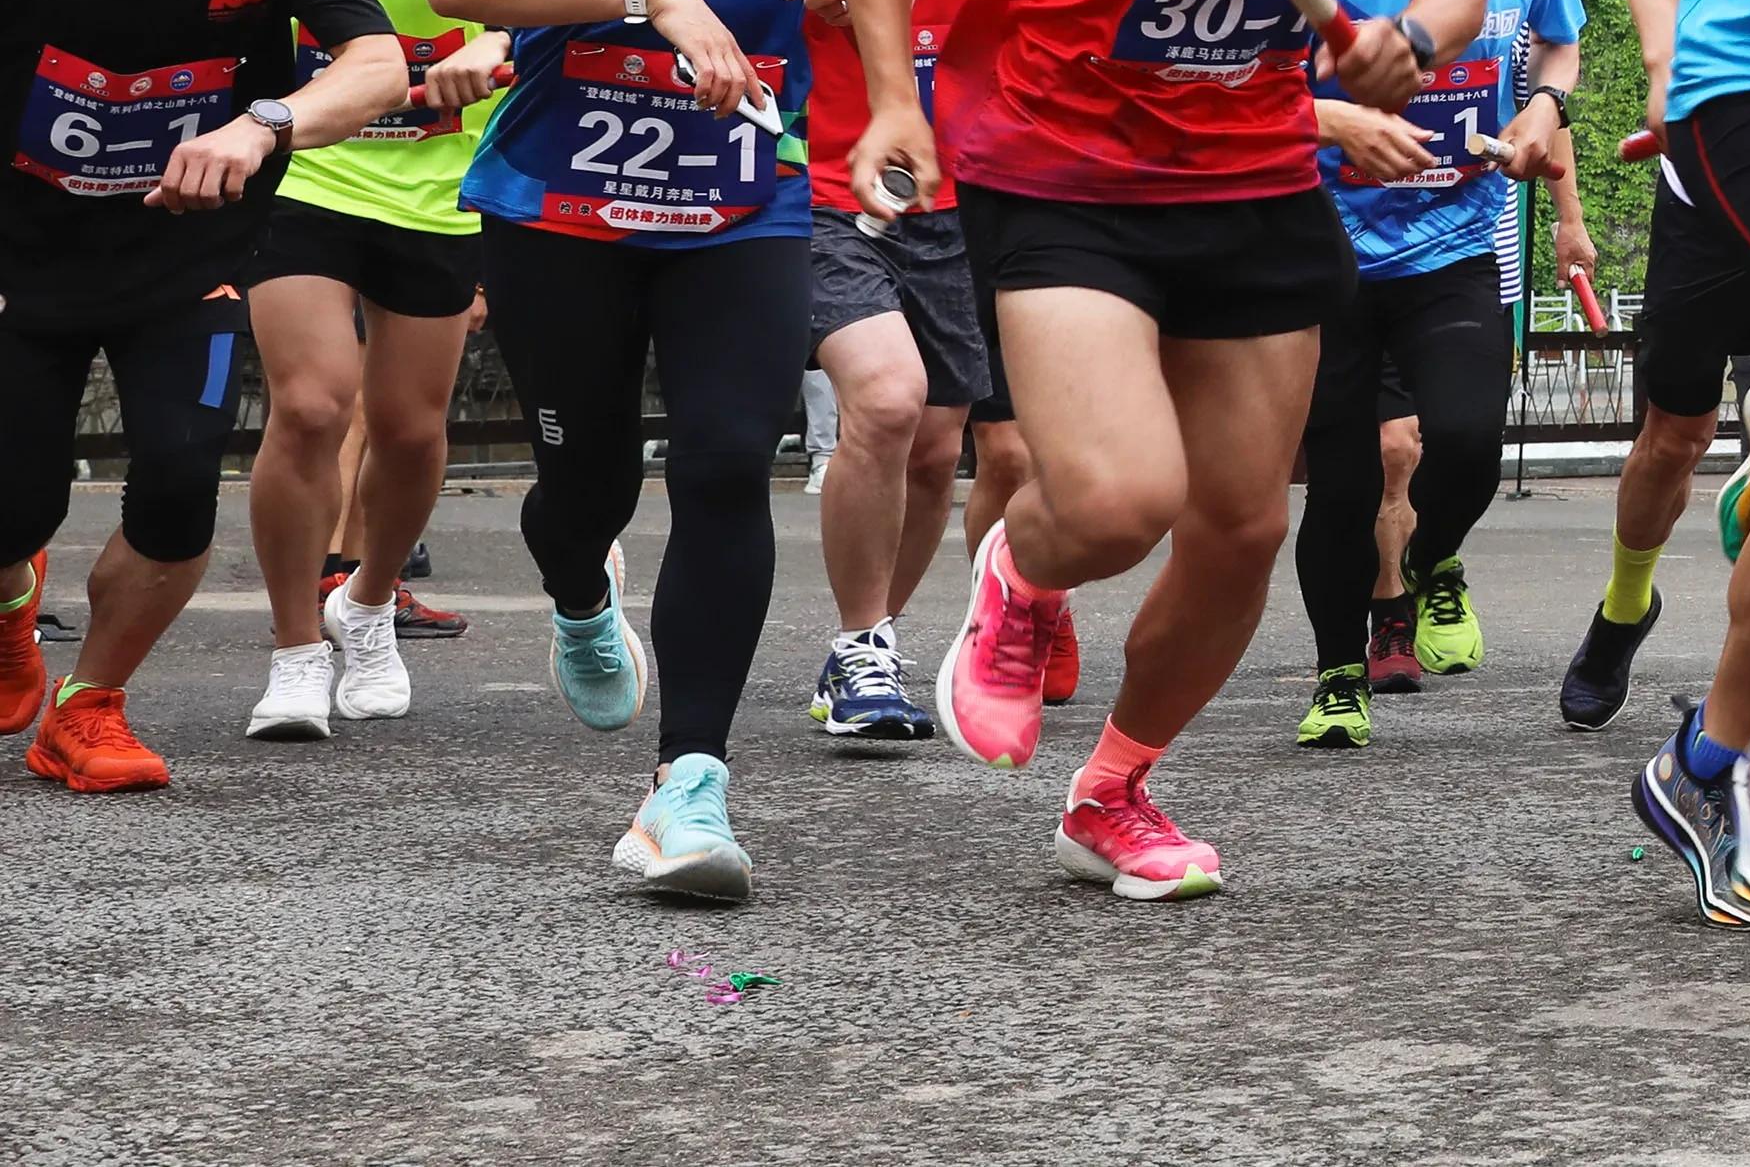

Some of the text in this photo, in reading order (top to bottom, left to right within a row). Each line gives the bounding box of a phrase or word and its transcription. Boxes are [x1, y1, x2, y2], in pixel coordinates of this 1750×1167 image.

[579, 85, 645, 106] “登峰越城”
[50, 111, 201, 158] 6-1
[571, 110, 757, 183] 22-1
[603, 180, 723, 202] 星星戴月奔跑一队
[609, 206, 713, 227] 团体接力挑战赛
